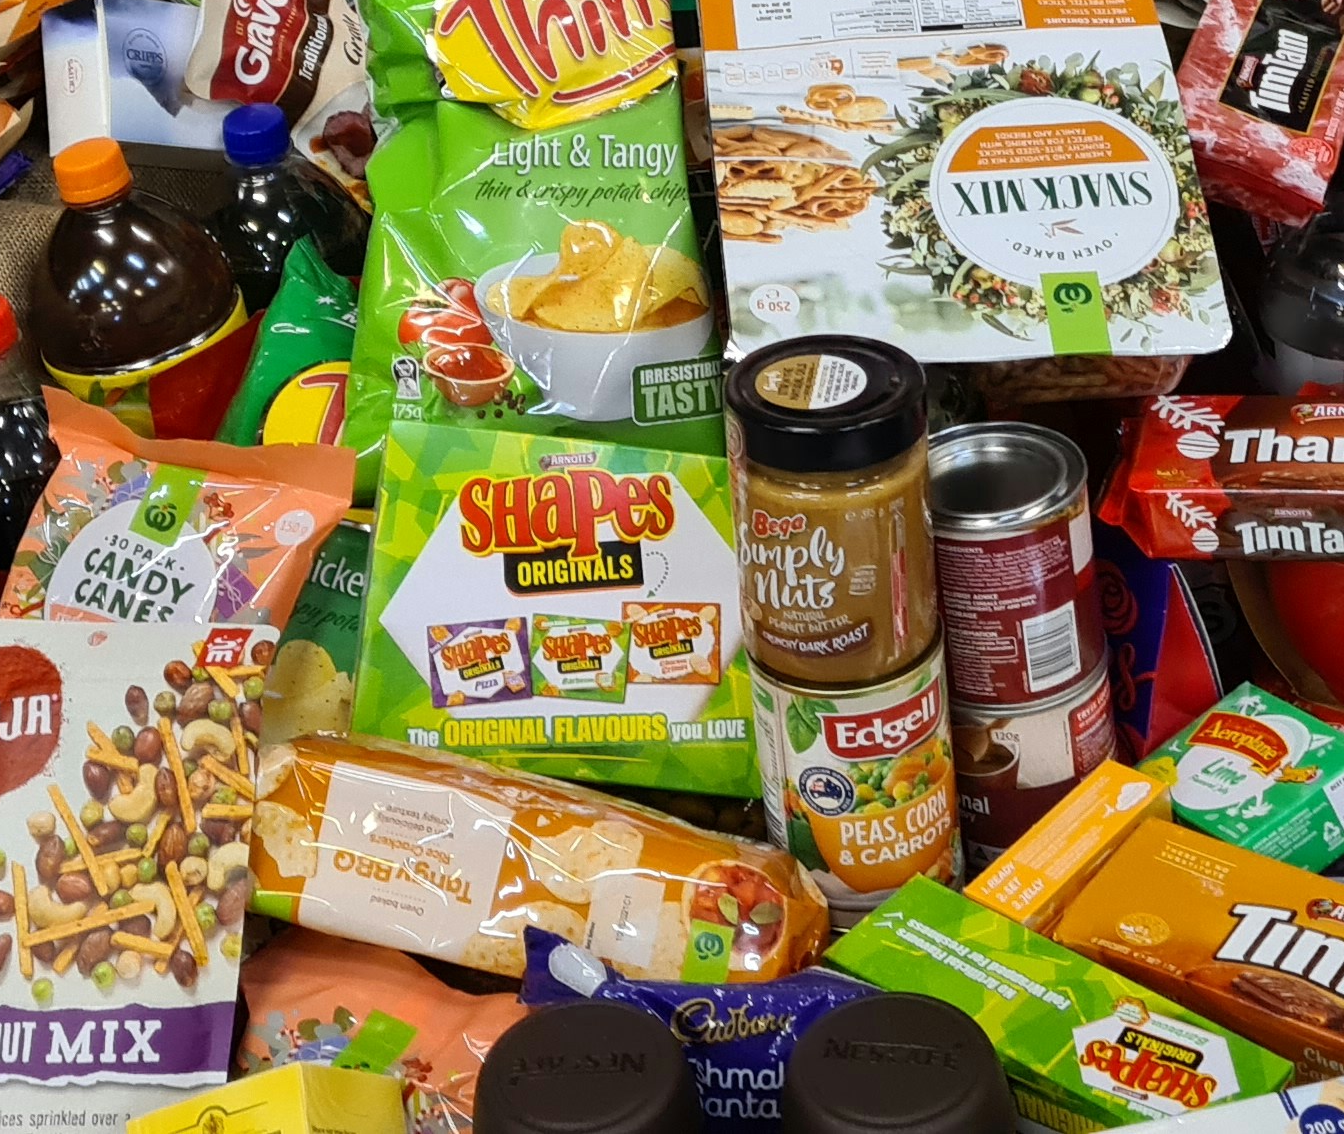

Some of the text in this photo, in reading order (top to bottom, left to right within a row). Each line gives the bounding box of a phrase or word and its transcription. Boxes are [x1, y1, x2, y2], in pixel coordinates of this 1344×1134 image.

[126, 48, 164, 64] CRIPPS
[1249, 28, 1310, 115] TimTam
[494, 135, 678, 176] Light Tangy
[957, 171, 1153, 217] SNACK MIX
[84, 548, 195, 605] CANDY
[517, 555, 634, 586] ORIGINALS
[799, 622, 869, 655] DARK ROAST
[407, 716, 745, 747] The ORIGINAL FLAVOURS you LOVE
[835, 697, 935, 750] Edgell
[839, 787, 947, 848] PEAS, CORN
[859, 820, 951, 864] CARROTS
[45, 1020, 159, 1064] MIX
[29, 1110, 87, 1130] sprinkled
[91, 1114, 118, 1126] over
